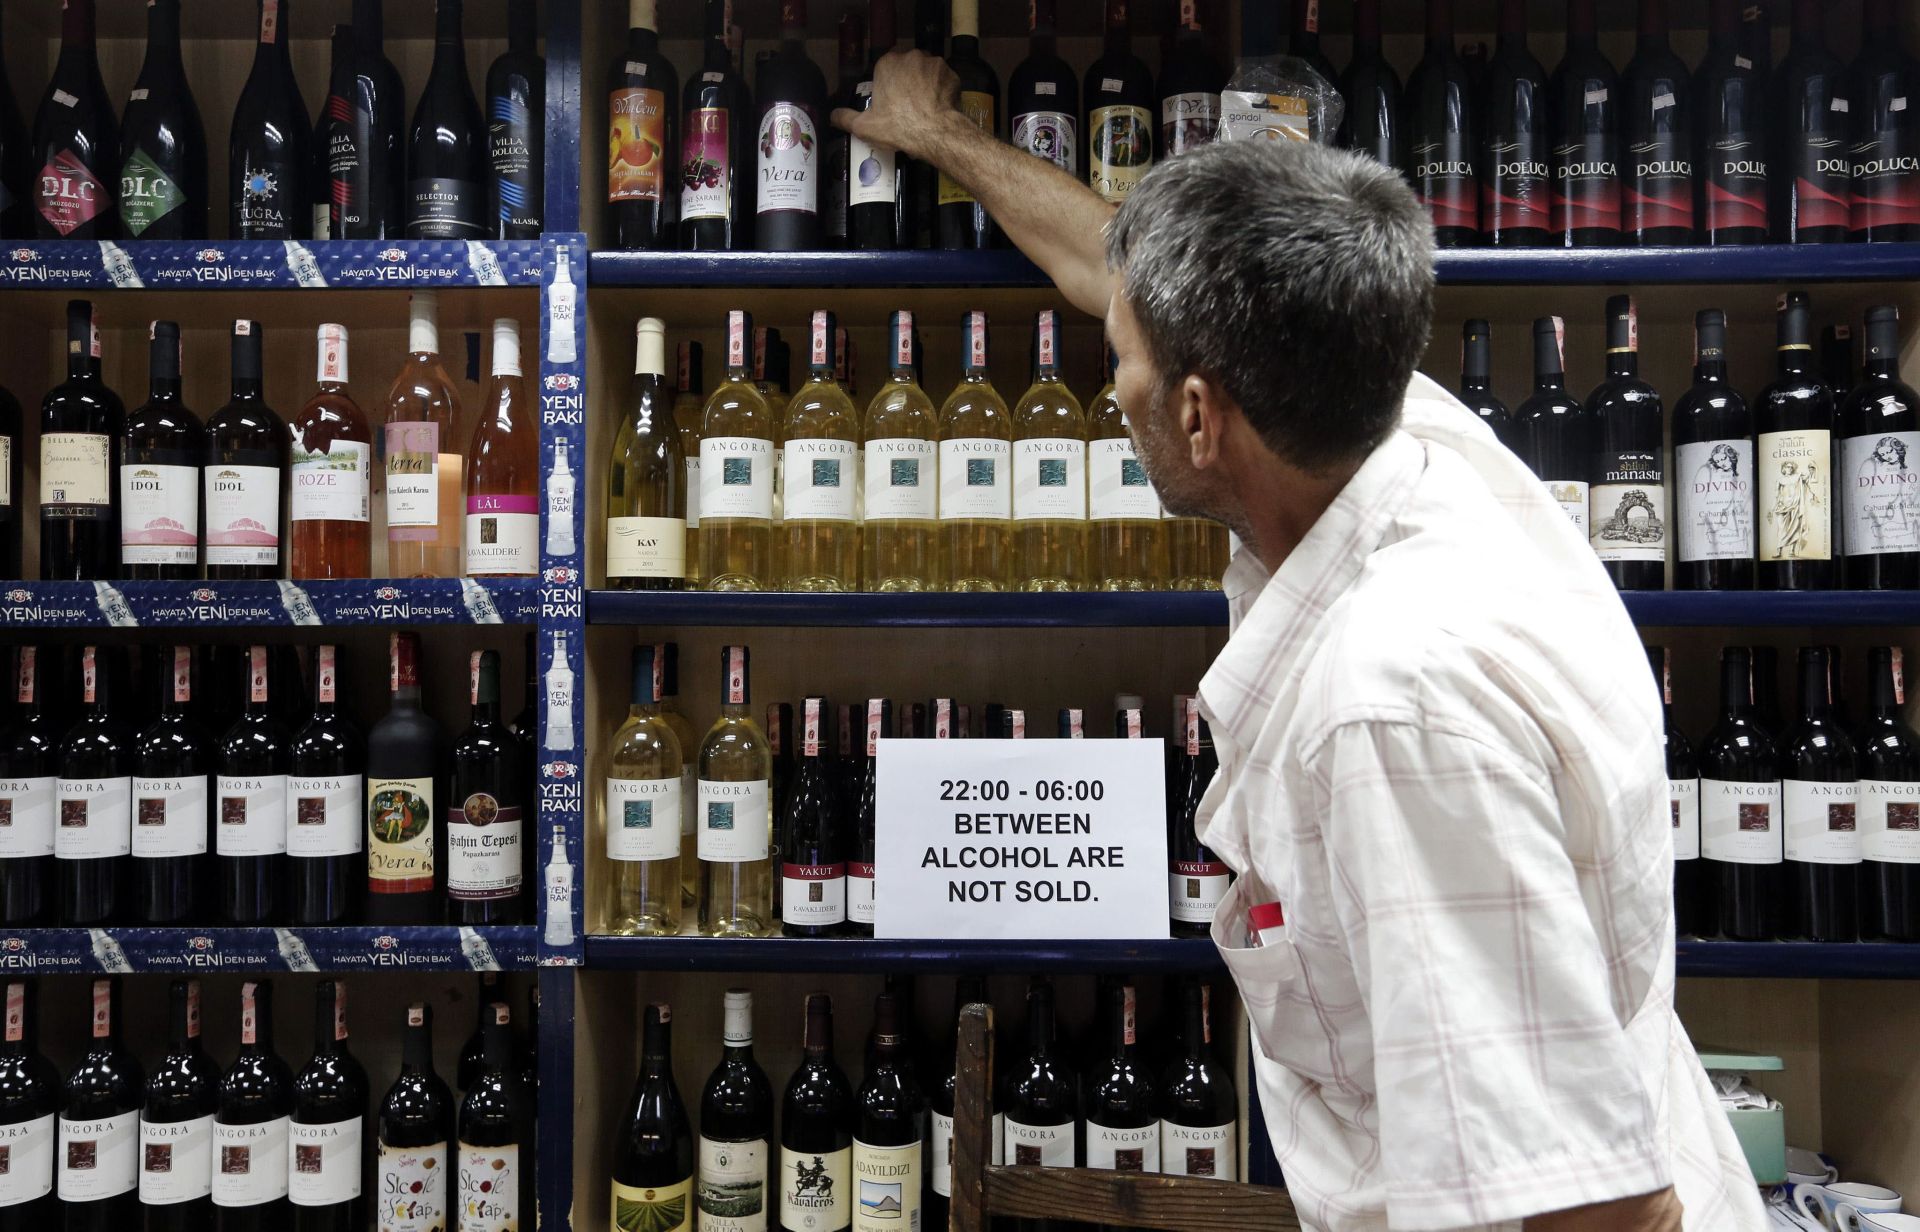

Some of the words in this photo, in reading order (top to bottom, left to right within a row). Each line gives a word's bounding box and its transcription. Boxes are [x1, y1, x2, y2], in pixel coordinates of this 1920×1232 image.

[1229, 112, 1261, 123] gondol
[492, 147, 530, 158] DOLUCA
[1417, 162, 1473, 178] DOLUCA
[1497, 161, 1549, 178] DOLUCA
[1558, 160, 1617, 179] DOLUCA
[1637, 160, 1692, 178] DOLUCA
[1853, 157, 1919, 178] DOLUCA
[762, 166, 808, 182] Vera
[42, 176, 95, 201] DLC
[121, 176, 167, 199] DLC
[416, 193, 459, 201] SELECTION
[241, 206, 284, 221] TUĞRA
[72, 269, 92, 277] BAK
[158, 269, 192, 277] HAYATA
[255, 269, 276, 277] BAK
[341, 269, 375, 277] HAYATA
[438, 268, 459, 277] BAK
[543, 411, 583, 425] RAKI
[710, 441, 767, 453] ANGORA
[798, 443, 853, 455] ANGORA
[877, 443, 932, 454] ANGORA
[953, 443, 1008, 454] ANGORA
[1025, 443, 1081, 454] ANGORA
[1772, 448, 1814, 459] classic
[299, 473, 337, 487] ROZE
[1859, 473, 1918, 488] DIVINO
[1695, 480, 1747, 494] DIVINO
[477, 496, 501, 509] LÂL
[637, 539, 659, 547] KAV
[66, 609, 87, 617] BAK
[152, 608, 187, 617] HAYATA
[250, 608, 271, 616] BAK
[335, 607, 370, 615] HAYATA
[433, 607, 454, 615] BAK
[542, 603, 581, 618] RAKI
[57, 783, 105, 793] NGORA
[133, 782, 182, 791] NGORA
[219, 780, 262, 790] NGORA
[612, 784, 669, 794] ANGORA
[699, 785, 752, 795] ANGORA
[939, 779, 1010, 801] 22:00
[1035, 779, 1105, 801] 06:00
[1722, 785, 1779, 796] ANGORA
[541, 799, 581, 813] RAKI
[955, 813, 1091, 834] BETWEEN
[481, 833, 518, 848] Tepesi
[373, 854, 417, 871] Vera
[921, 846, 1058, 869] ALCOHOL
[1066, 846, 1125, 869] ARE
[800, 867, 833, 876] YAKUT
[1178, 863, 1211, 873] YAKUT
[949, 880, 1007, 903] NOT
[1015, 880, 1099, 903] SOLD.
[793, 904, 838, 913] KAVAKLIDERE
[61, 957, 82, 965] BAK
[148, 956, 183, 964] HAYATA
[332, 955, 367, 964] HAYATA
[431, 955, 452, 963] BAK
[141, 1126, 189, 1137] NGORA
[1008, 1124, 1056, 1139] ANGORA
[1101, 1131, 1154, 1142] ANGORA
[1173, 1129, 1227, 1141] ANGORA
[856, 1161, 910, 1176] ADAYILDIZI
